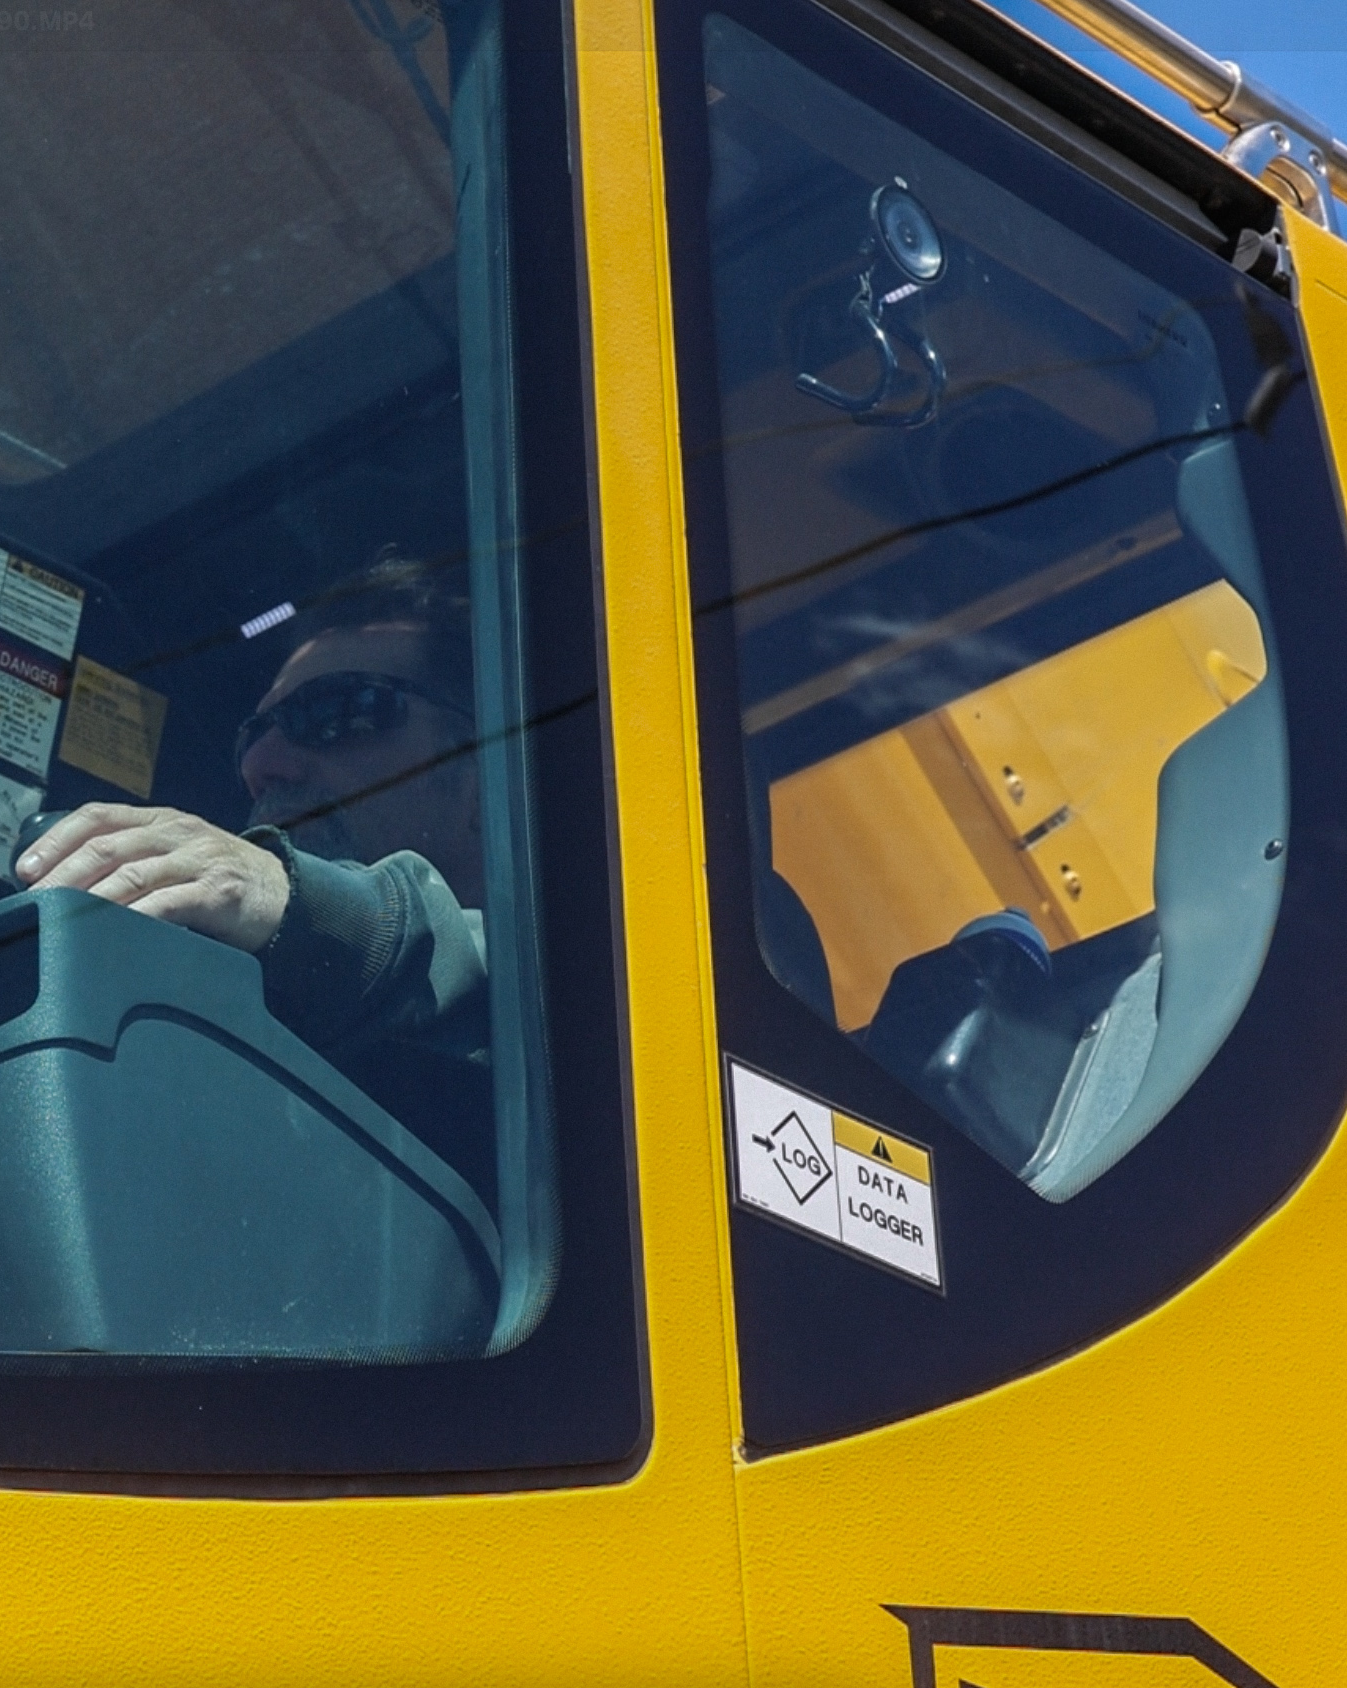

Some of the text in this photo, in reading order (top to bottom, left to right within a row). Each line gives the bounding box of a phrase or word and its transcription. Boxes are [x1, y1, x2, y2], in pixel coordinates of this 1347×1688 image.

[781, 1142, 821, 1176] LOG
[857, 1165, 909, 1204] DATA
[848, 1196, 924, 1246] LOGGER
